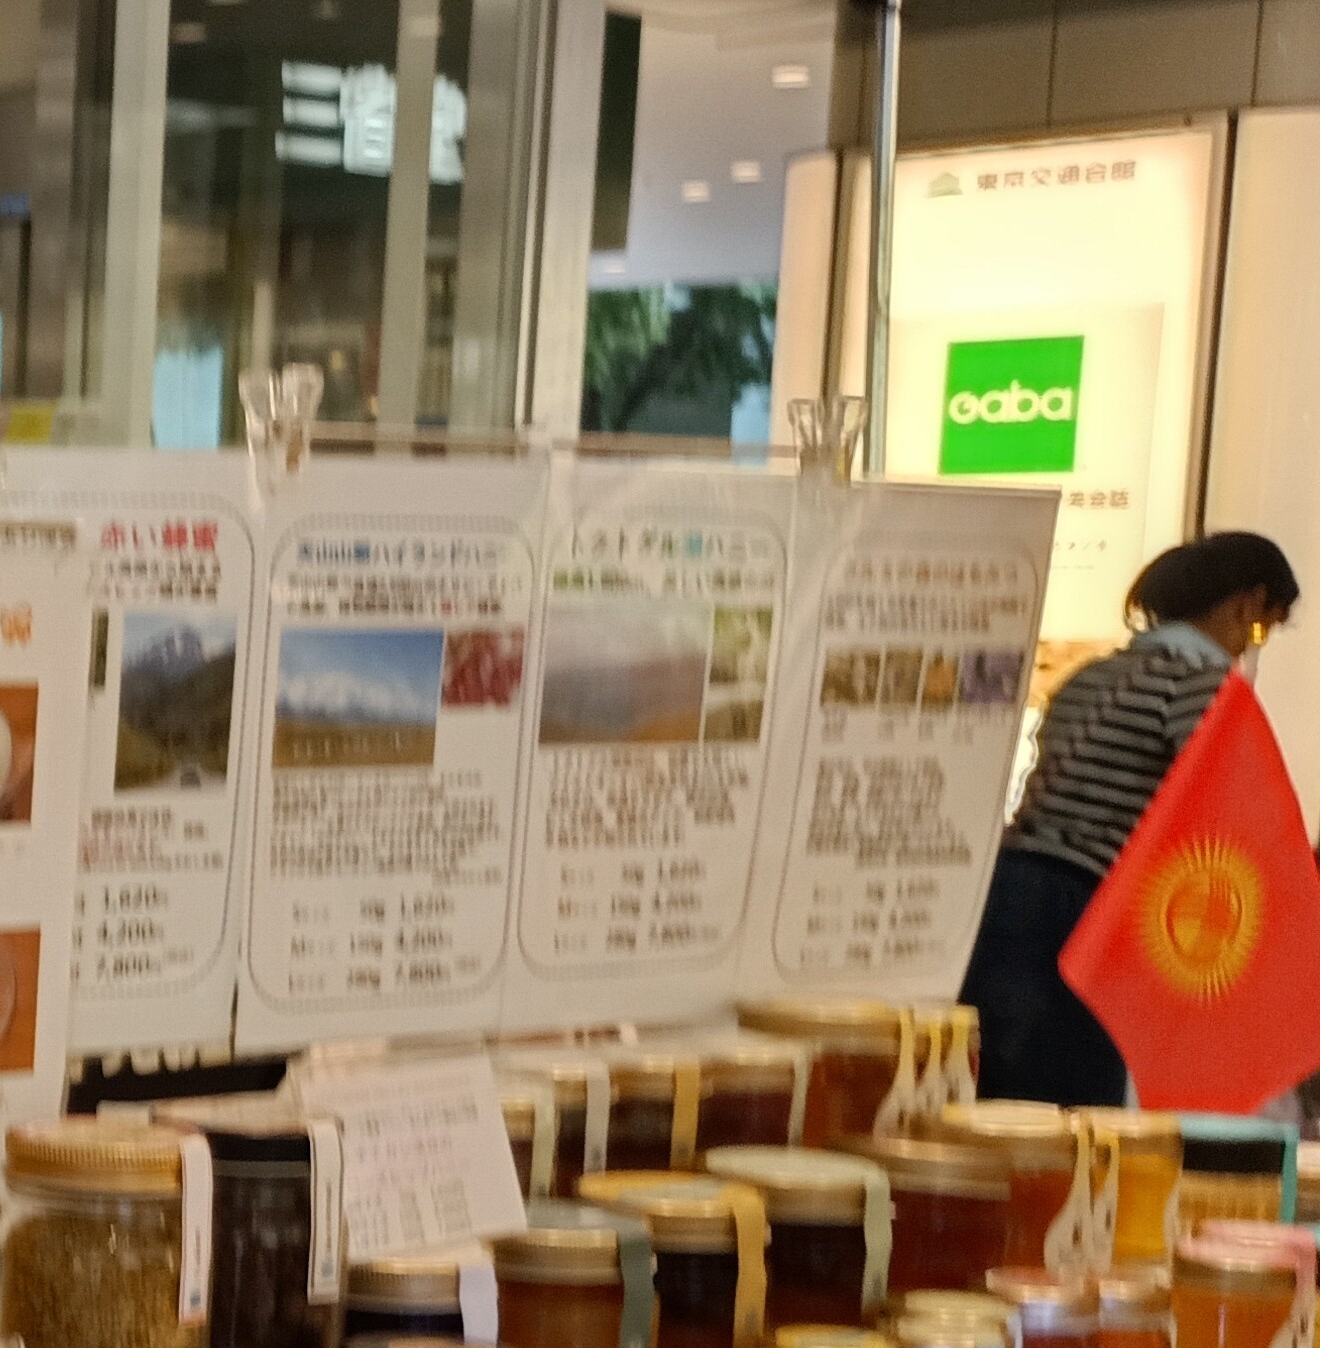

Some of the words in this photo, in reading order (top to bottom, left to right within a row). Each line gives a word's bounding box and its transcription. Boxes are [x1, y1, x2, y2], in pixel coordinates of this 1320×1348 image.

[977, 159, 1137, 192] 東京交通会館
